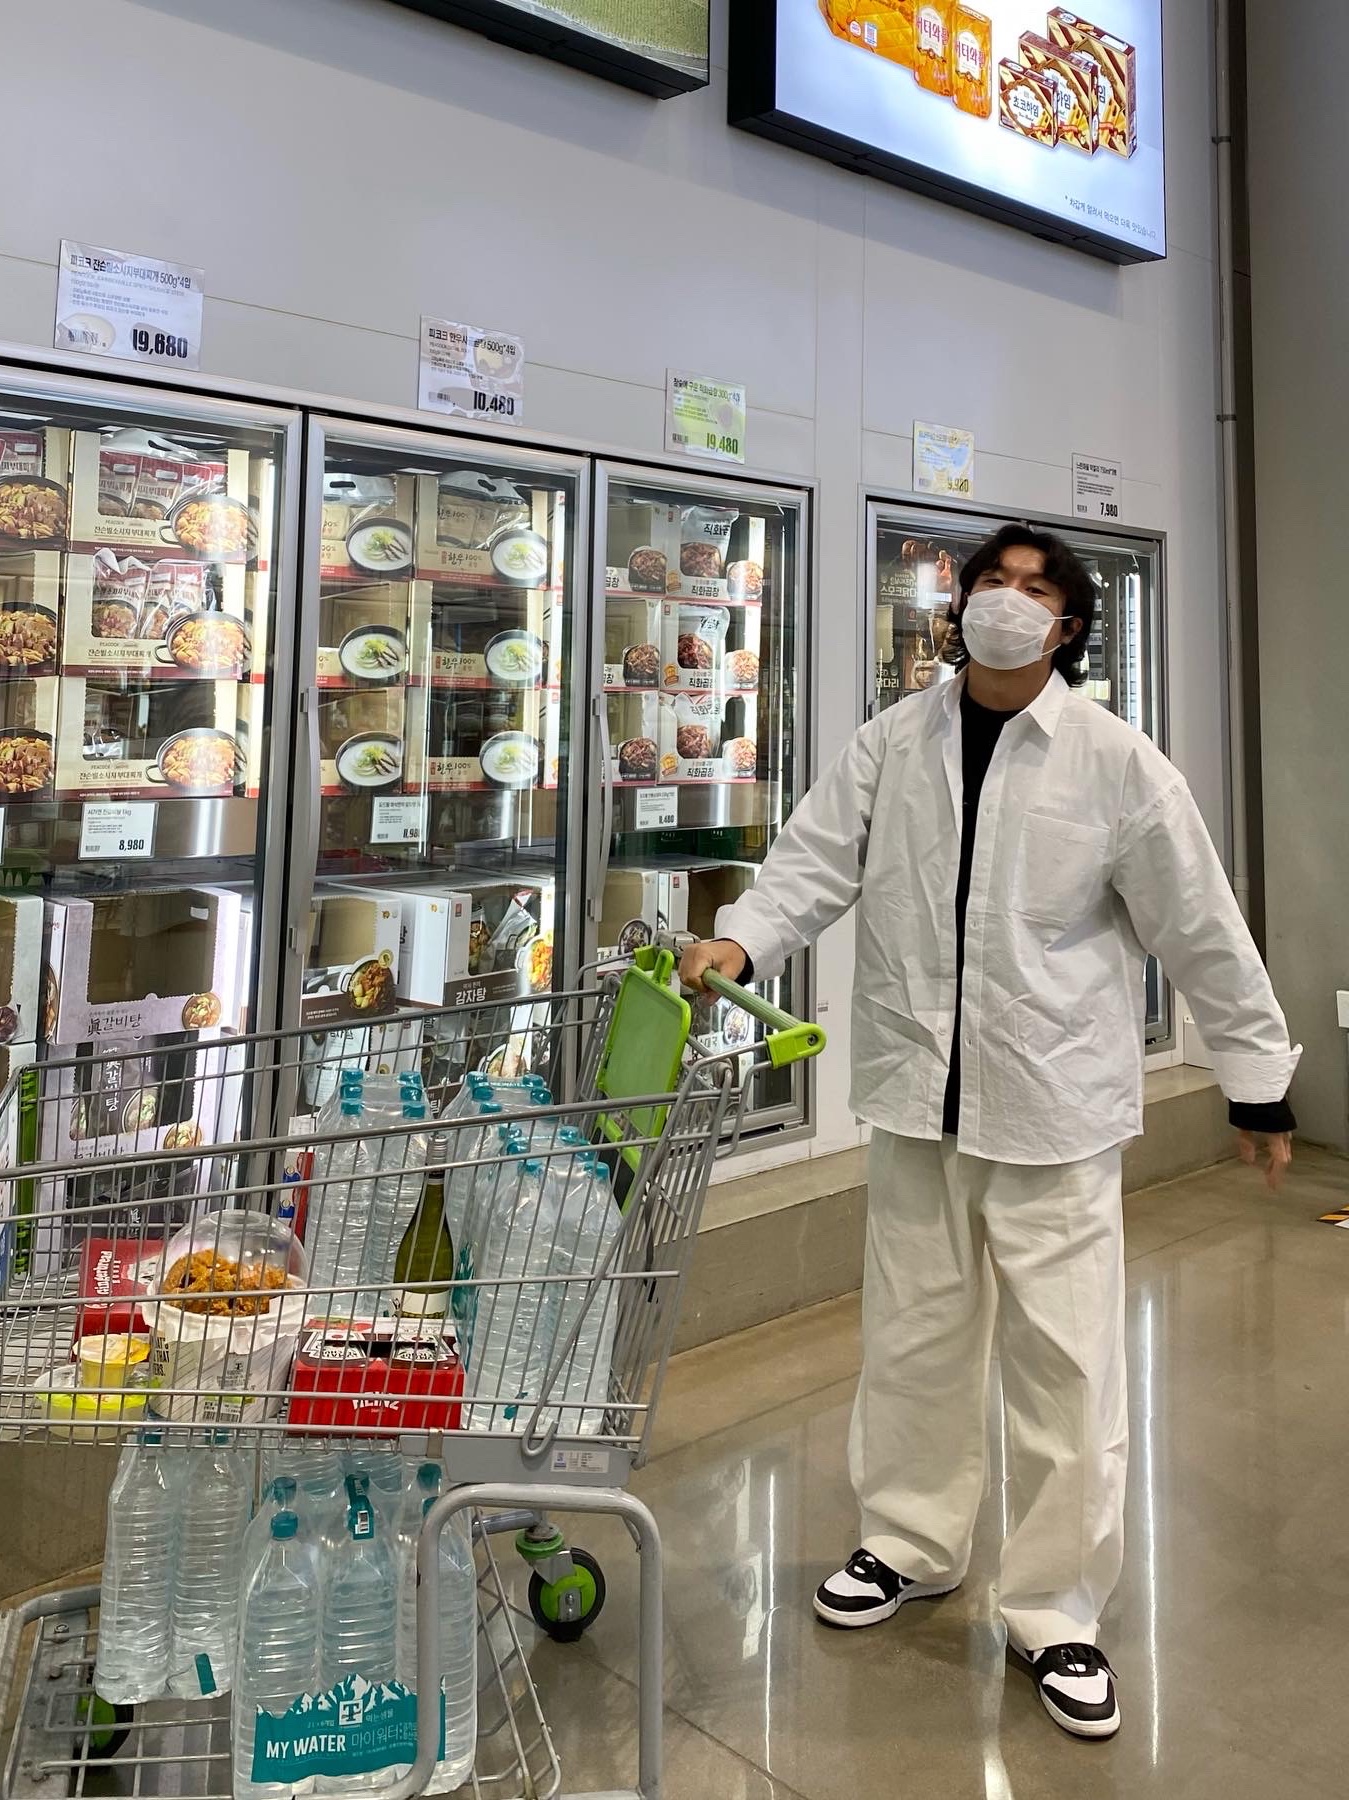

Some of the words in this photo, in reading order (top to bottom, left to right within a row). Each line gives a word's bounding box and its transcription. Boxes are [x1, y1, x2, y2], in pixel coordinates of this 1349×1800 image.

[1013, 95, 1039, 118] 초코하임
[1069, 198, 1086, 212] 차갑게
[70, 254, 92, 268] 피코크
[428, 327, 448, 341] 피코크
[132, 328, 188, 359] 19,680
[473, 390, 515, 416] 10,480
[706, 432, 739, 455] 19,480
[1100, 502, 1118, 518] 7,980
[447, 551, 464, 566] 한우
[690, 584, 720, 598] 직화곱창
[880, 585, 917, 599] 스모크닭다
[442, 656, 459, 670] 한우
[437, 761, 454, 775] 한우
[118, 838, 145, 851] 8,980
[455, 986, 487, 1006] 감자탕
[92, 1250, 113, 1295] Gingerbread
[112, 1259, 122, 1284] HOUSE
[351, 1724, 399, 1749] 마이워터
[266, 1740, 290, 1759] MY
[293, 1734, 346, 1757] WATER
